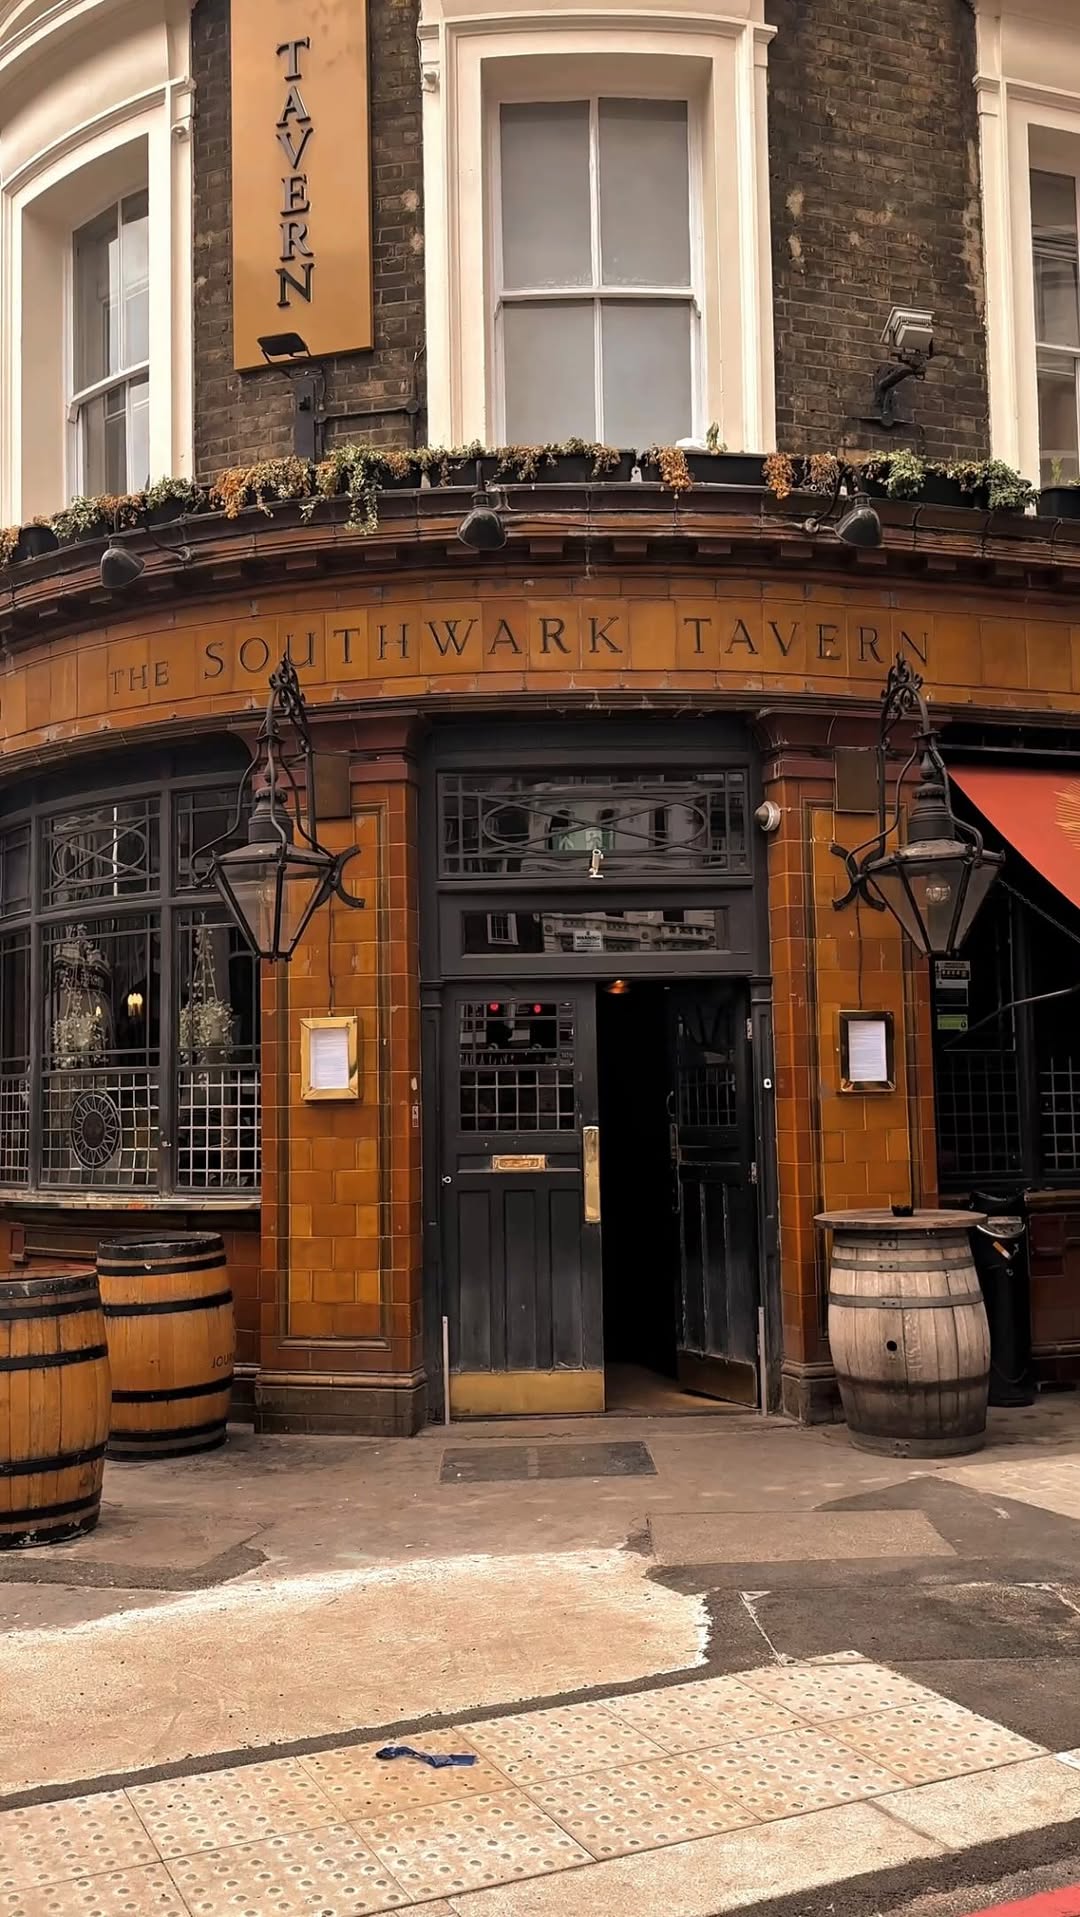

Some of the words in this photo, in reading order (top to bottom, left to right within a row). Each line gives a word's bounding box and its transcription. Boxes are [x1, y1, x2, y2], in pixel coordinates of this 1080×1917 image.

[275, 36, 315, 308] TAVERN
[109, 660, 170, 695] THE
[204, 616, 623, 680] SOUTHWARK
[684, 617, 929, 666] TAVERN
